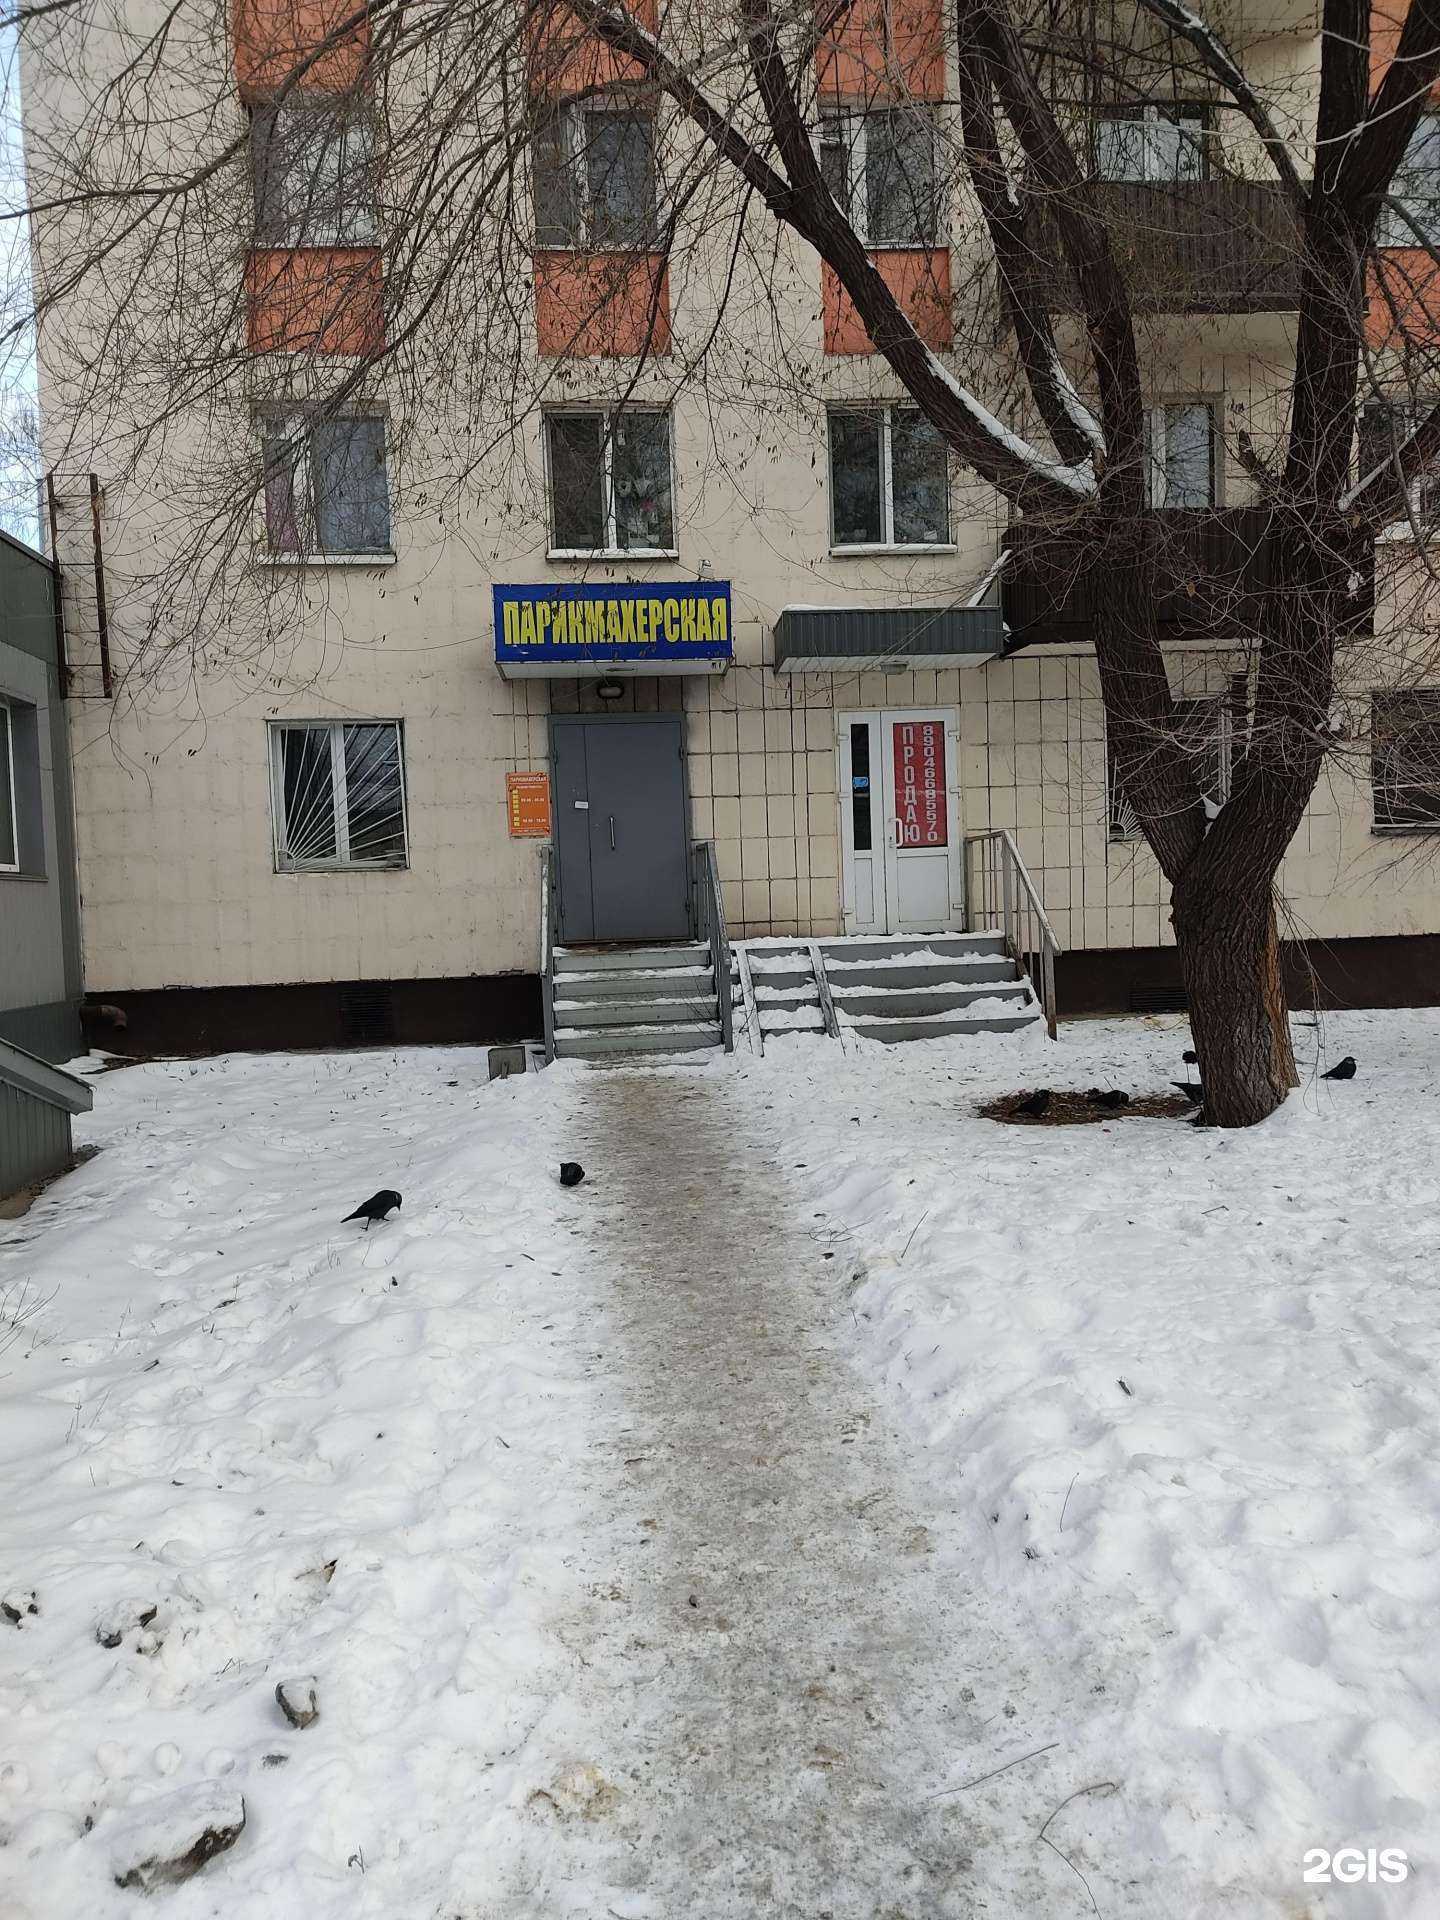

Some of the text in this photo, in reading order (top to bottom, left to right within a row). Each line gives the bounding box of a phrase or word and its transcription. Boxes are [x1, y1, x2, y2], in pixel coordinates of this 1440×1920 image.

[502, 598, 728, 645] ПАРИКМАХЕРСКАЯ
[903, 726, 920, 842] ПРОДАЮ
[922, 725, 937, 841] 89046685570
